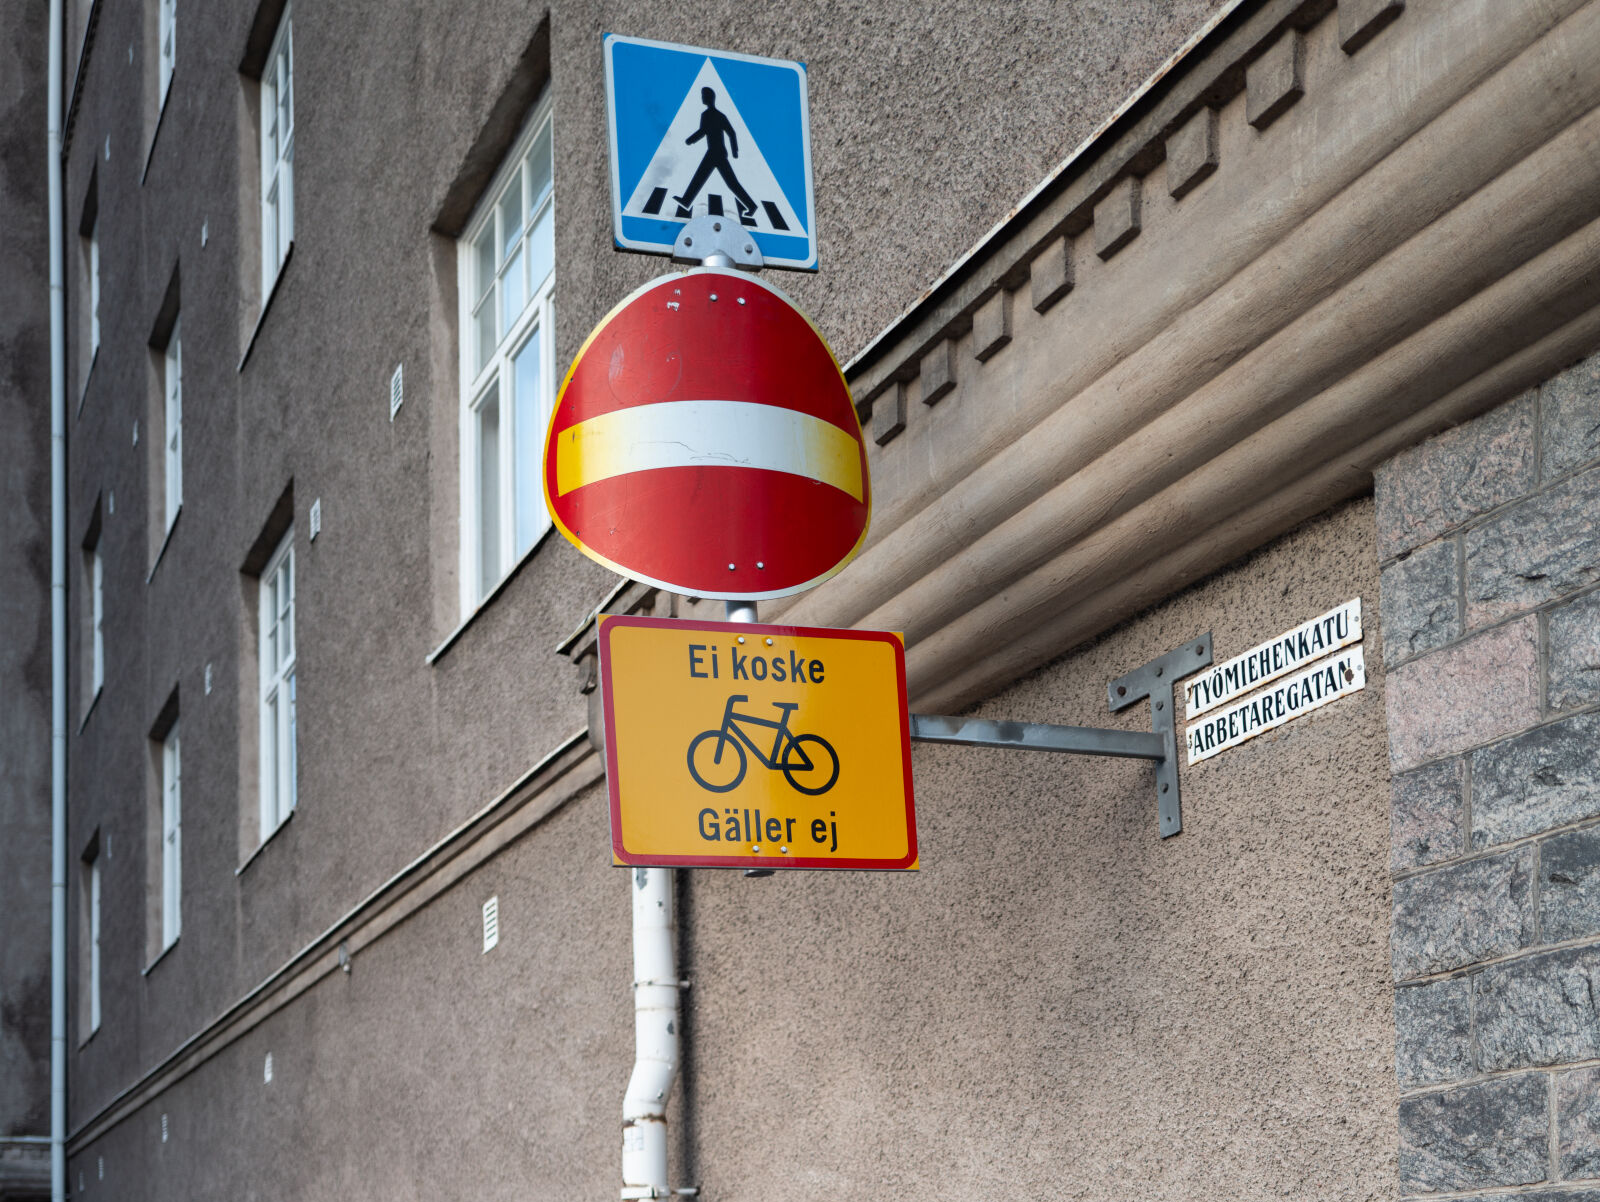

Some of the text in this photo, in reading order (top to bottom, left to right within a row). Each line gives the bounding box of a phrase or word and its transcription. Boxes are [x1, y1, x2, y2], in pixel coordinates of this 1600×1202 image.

[688, 644, 826, 684] Ei koske
[1192, 608, 1349, 710] TYÖMIEHENKATU
[1192, 657, 1352, 757] ARBETAREGATAN
[698, 807, 839, 853] Gäller ej
